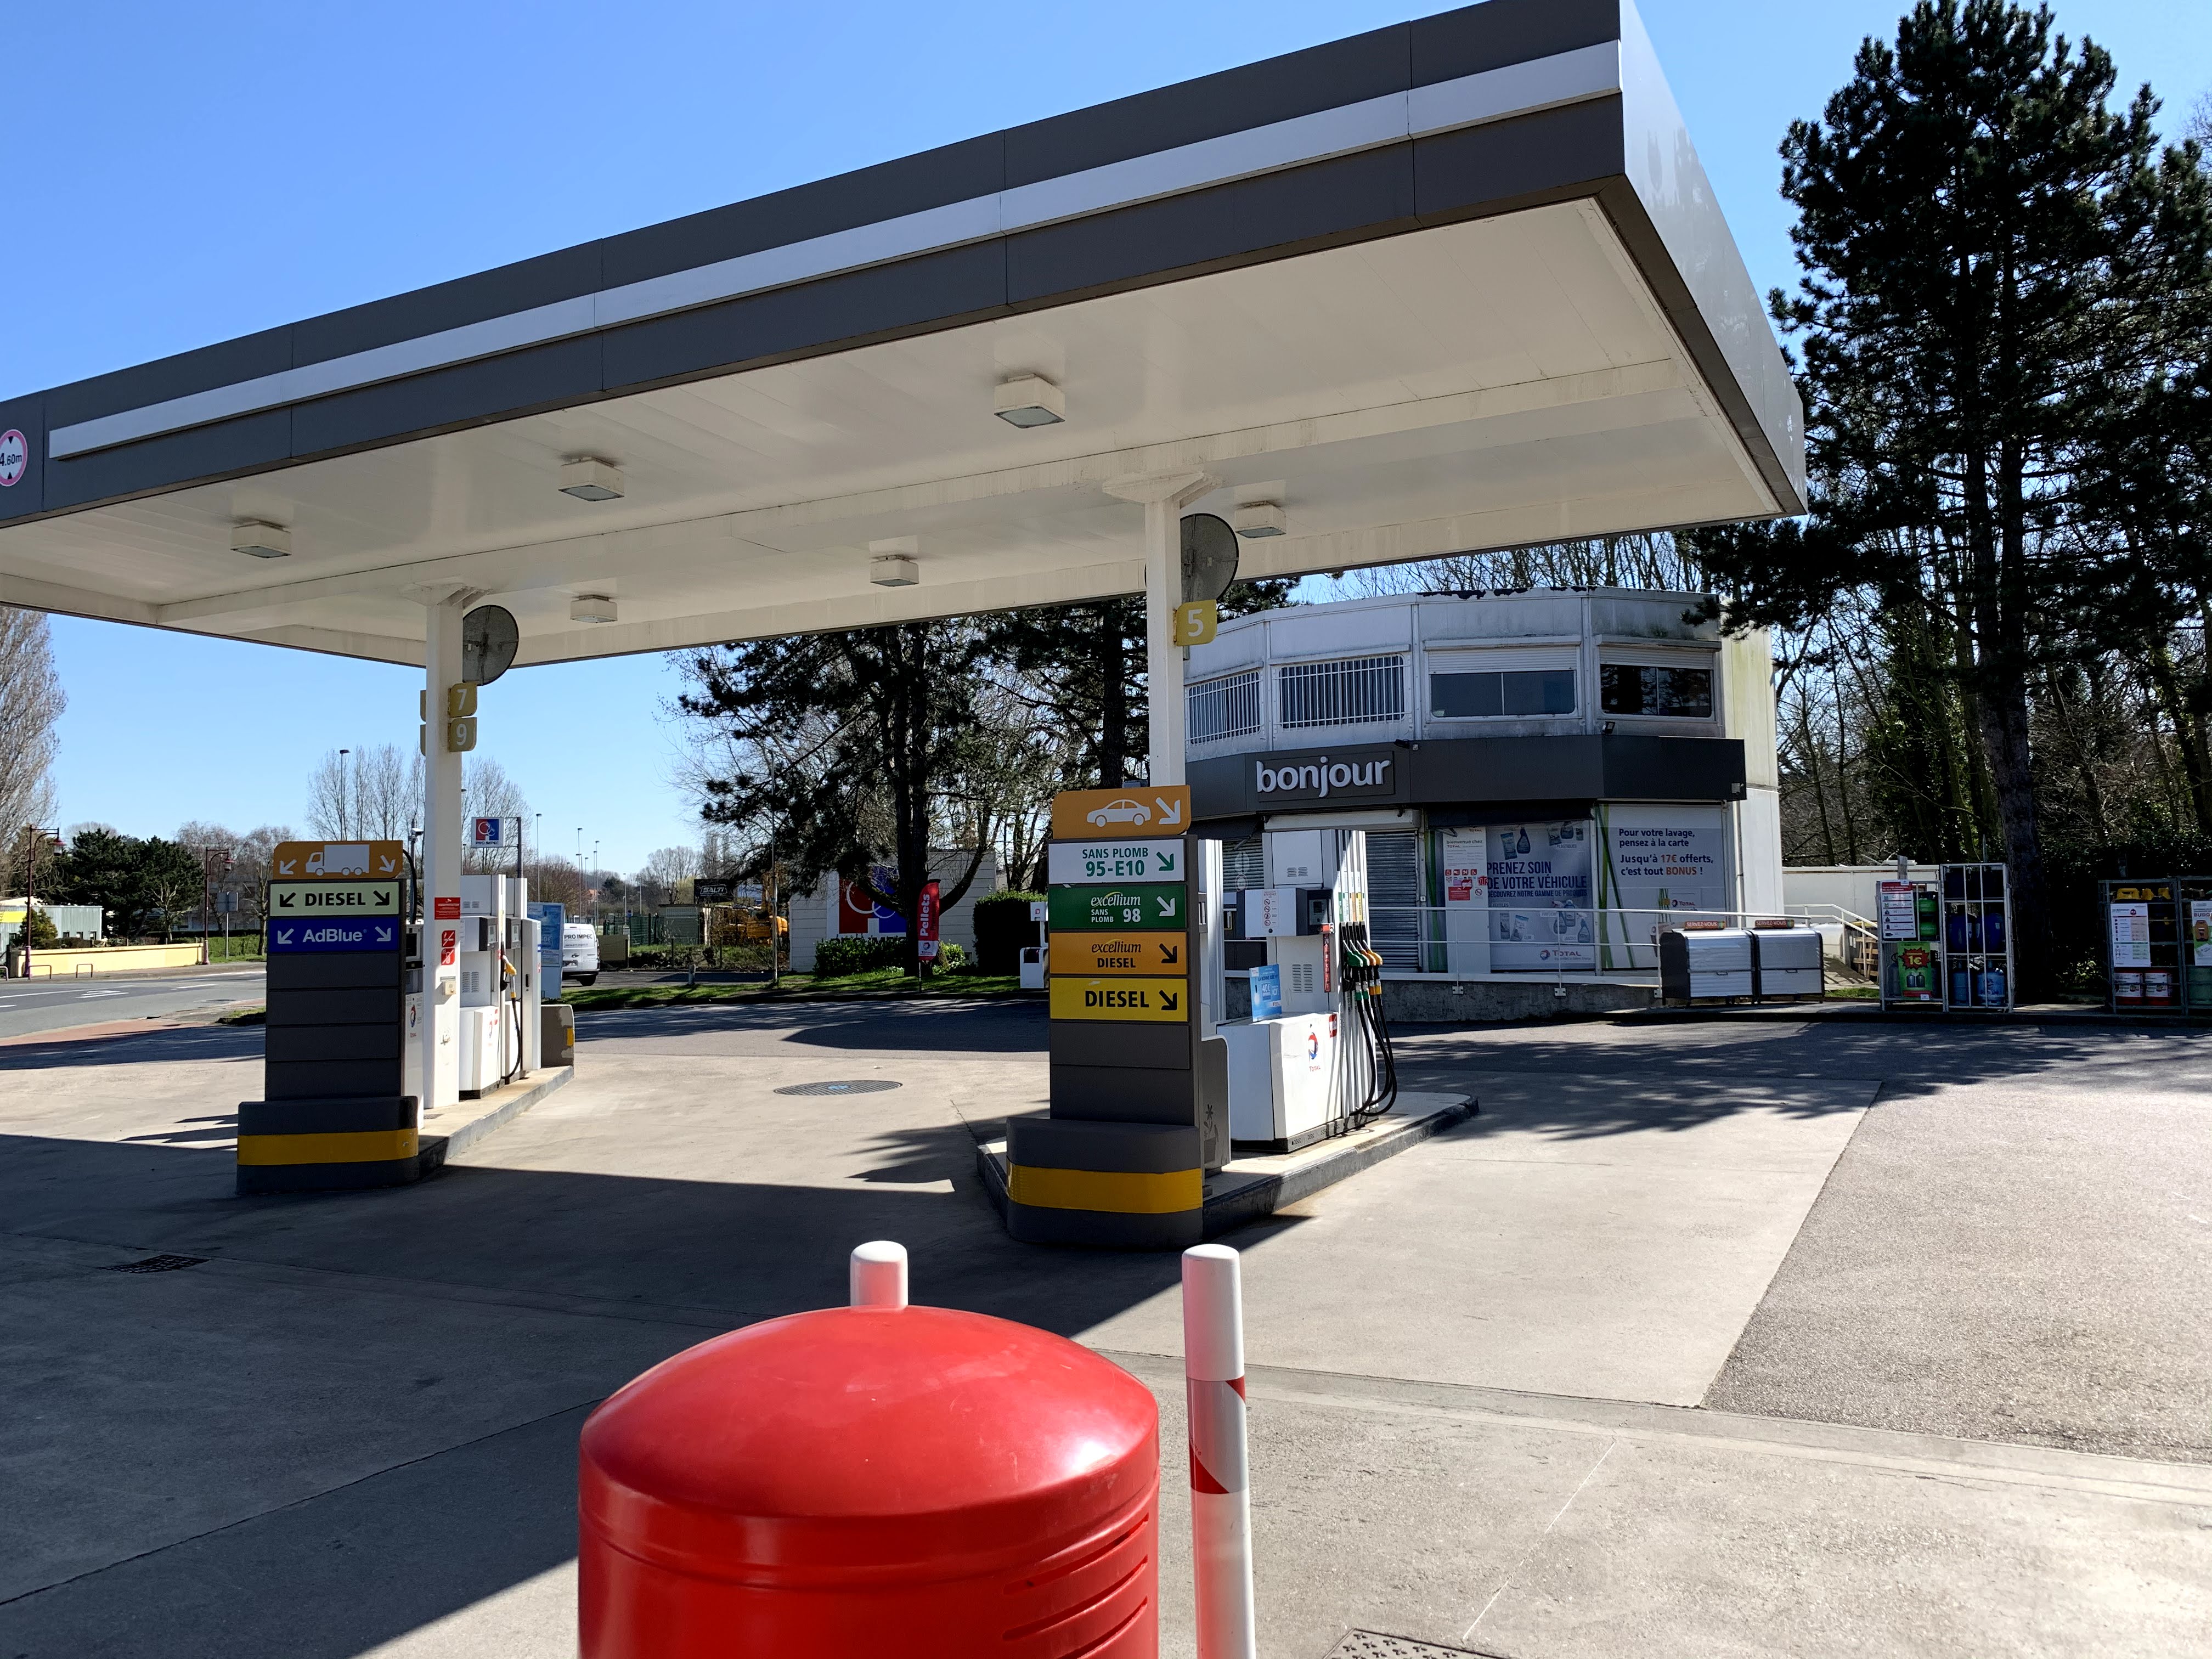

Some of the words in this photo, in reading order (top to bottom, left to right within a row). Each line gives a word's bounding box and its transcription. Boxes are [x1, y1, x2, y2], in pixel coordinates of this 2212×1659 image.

[0, 453, 22, 466] 4.60m
[1188, 609, 1204, 636] 5
[456, 689, 467, 710] 7
[456, 724, 467, 746] 9
[1256, 756, 1391, 797] bonjour
[1619, 828, 1639, 837] Pour
[1666, 828, 1695, 838] lavage,
[1620, 840, 1649, 848] pensez
[1651, 838, 1656, 847] à
[1658, 838, 1666, 847] la
[1082, 849, 1109, 859] SANS
[1113, 848, 1148, 857] PLOMB
[1621, 854, 1658, 865] Jusqu'à
[1661, 855, 1677, 863] 17€
[1679, 854, 1713, 864] offerts,
[1086, 860, 1144, 877] 95-E10
[1487, 862, 1525, 874] PRENEZ
[1528, 861, 1551, 874] SOIN
[1621, 867, 1641, 876] c'est
[1644, 867, 1663, 876] tout
[1666, 867, 1697, 875] BONUS
[1487, 877, 1499, 889] DE
[1502, 876, 1535, 889] VOTRE
[1537, 874, 1587, 889] VÉHICULE
[305, 893, 366, 906] DIESEL
[1091, 893, 1141, 906] excellium
[1488, 890, 1516, 898] DÉCOUVREZ
[920, 894, 930, 936] Pellets
[1123, 909, 1141, 922] 98
[302, 929, 363, 943] AdBlue
[1091, 941, 1142, 953] excellium
[1097, 958, 1136, 968] DIESEL
[1908, 956, 1922, 965] 1€
[1262, 983, 1271, 992] 40€
[1085, 990, 1149, 1007] DIESEL
